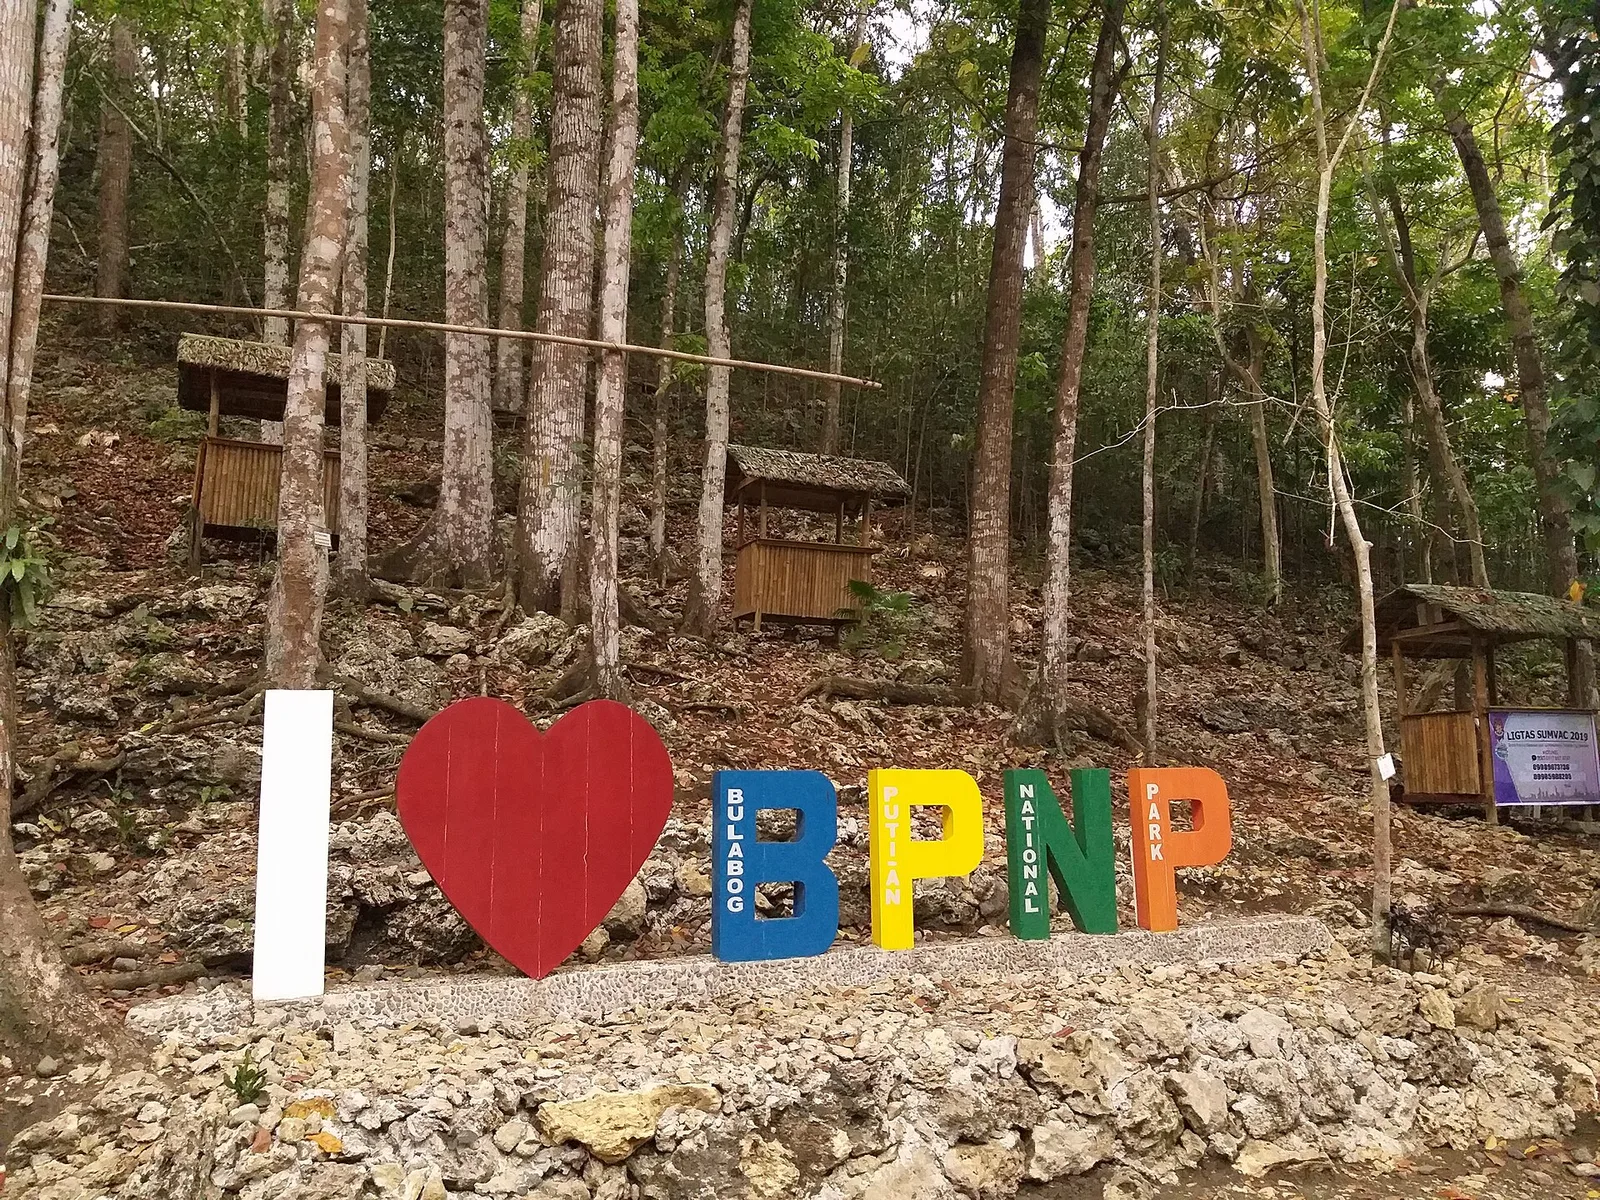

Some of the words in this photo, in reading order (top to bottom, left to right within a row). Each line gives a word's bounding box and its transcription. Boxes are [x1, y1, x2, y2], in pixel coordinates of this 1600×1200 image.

[1506, 730, 1536, 741] LIGTAS
[1536, 729, 1569, 740] SUMVAC
[1570, 731, 1589, 742] 2019
[252, 689, 334, 1000] I
[727, 788, 744, 913] BULABOG
[883, 786, 900, 905] PUTI-AN
[1019, 779, 1039, 913] NATIONAL
[1146, 783, 1164, 861] PARK
